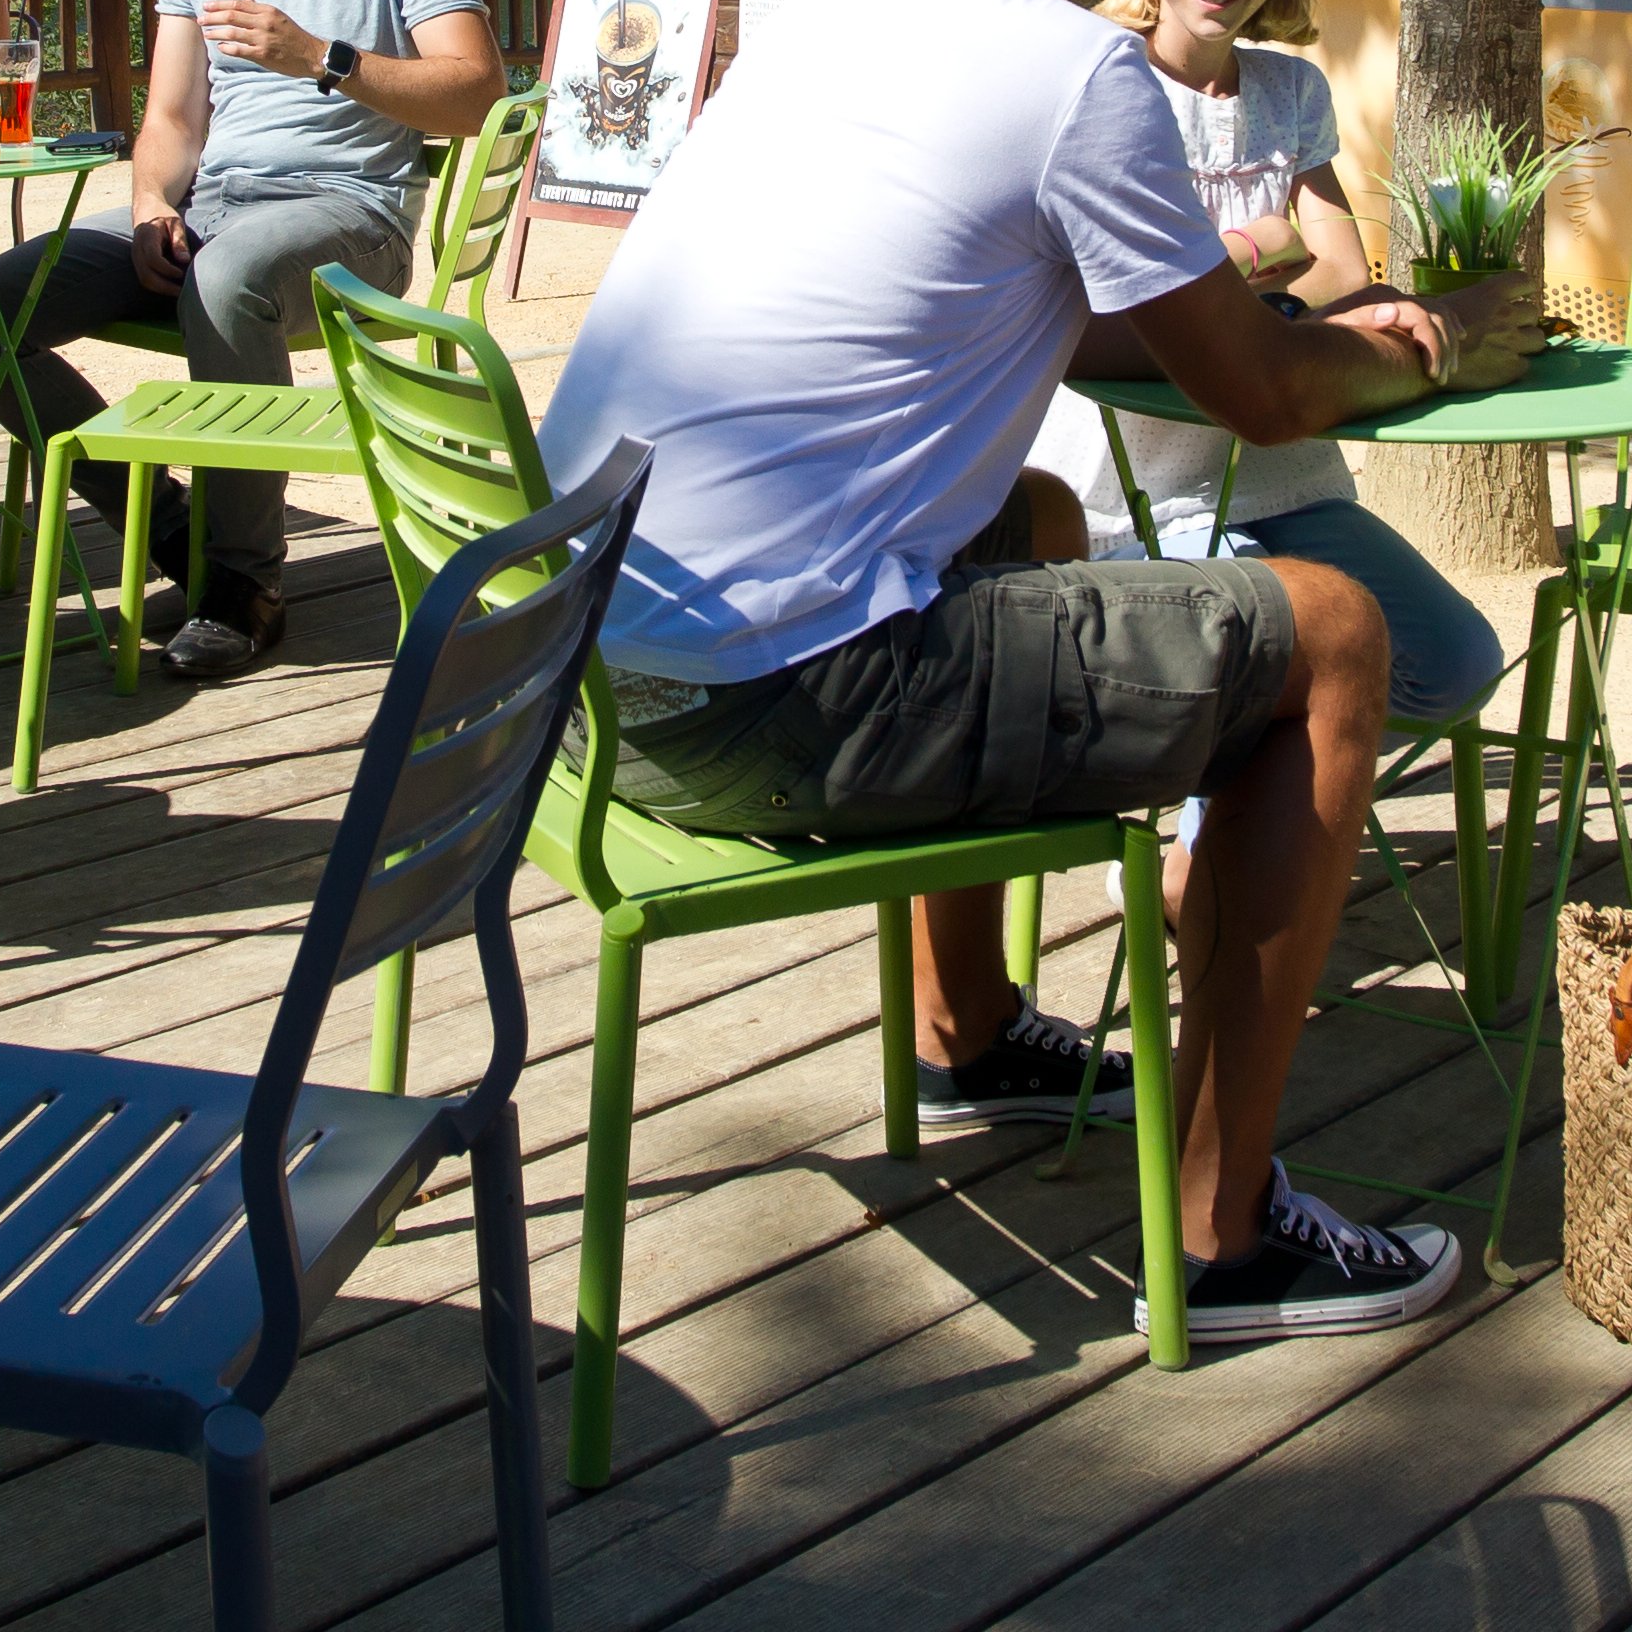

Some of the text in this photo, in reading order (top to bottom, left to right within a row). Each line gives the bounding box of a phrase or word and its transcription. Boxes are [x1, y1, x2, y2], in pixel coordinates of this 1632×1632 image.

[540, 184, 591, 203] EVERYTHING
[591, 189, 624, 208] STARTS
[624, 193, 639, 209] AT
